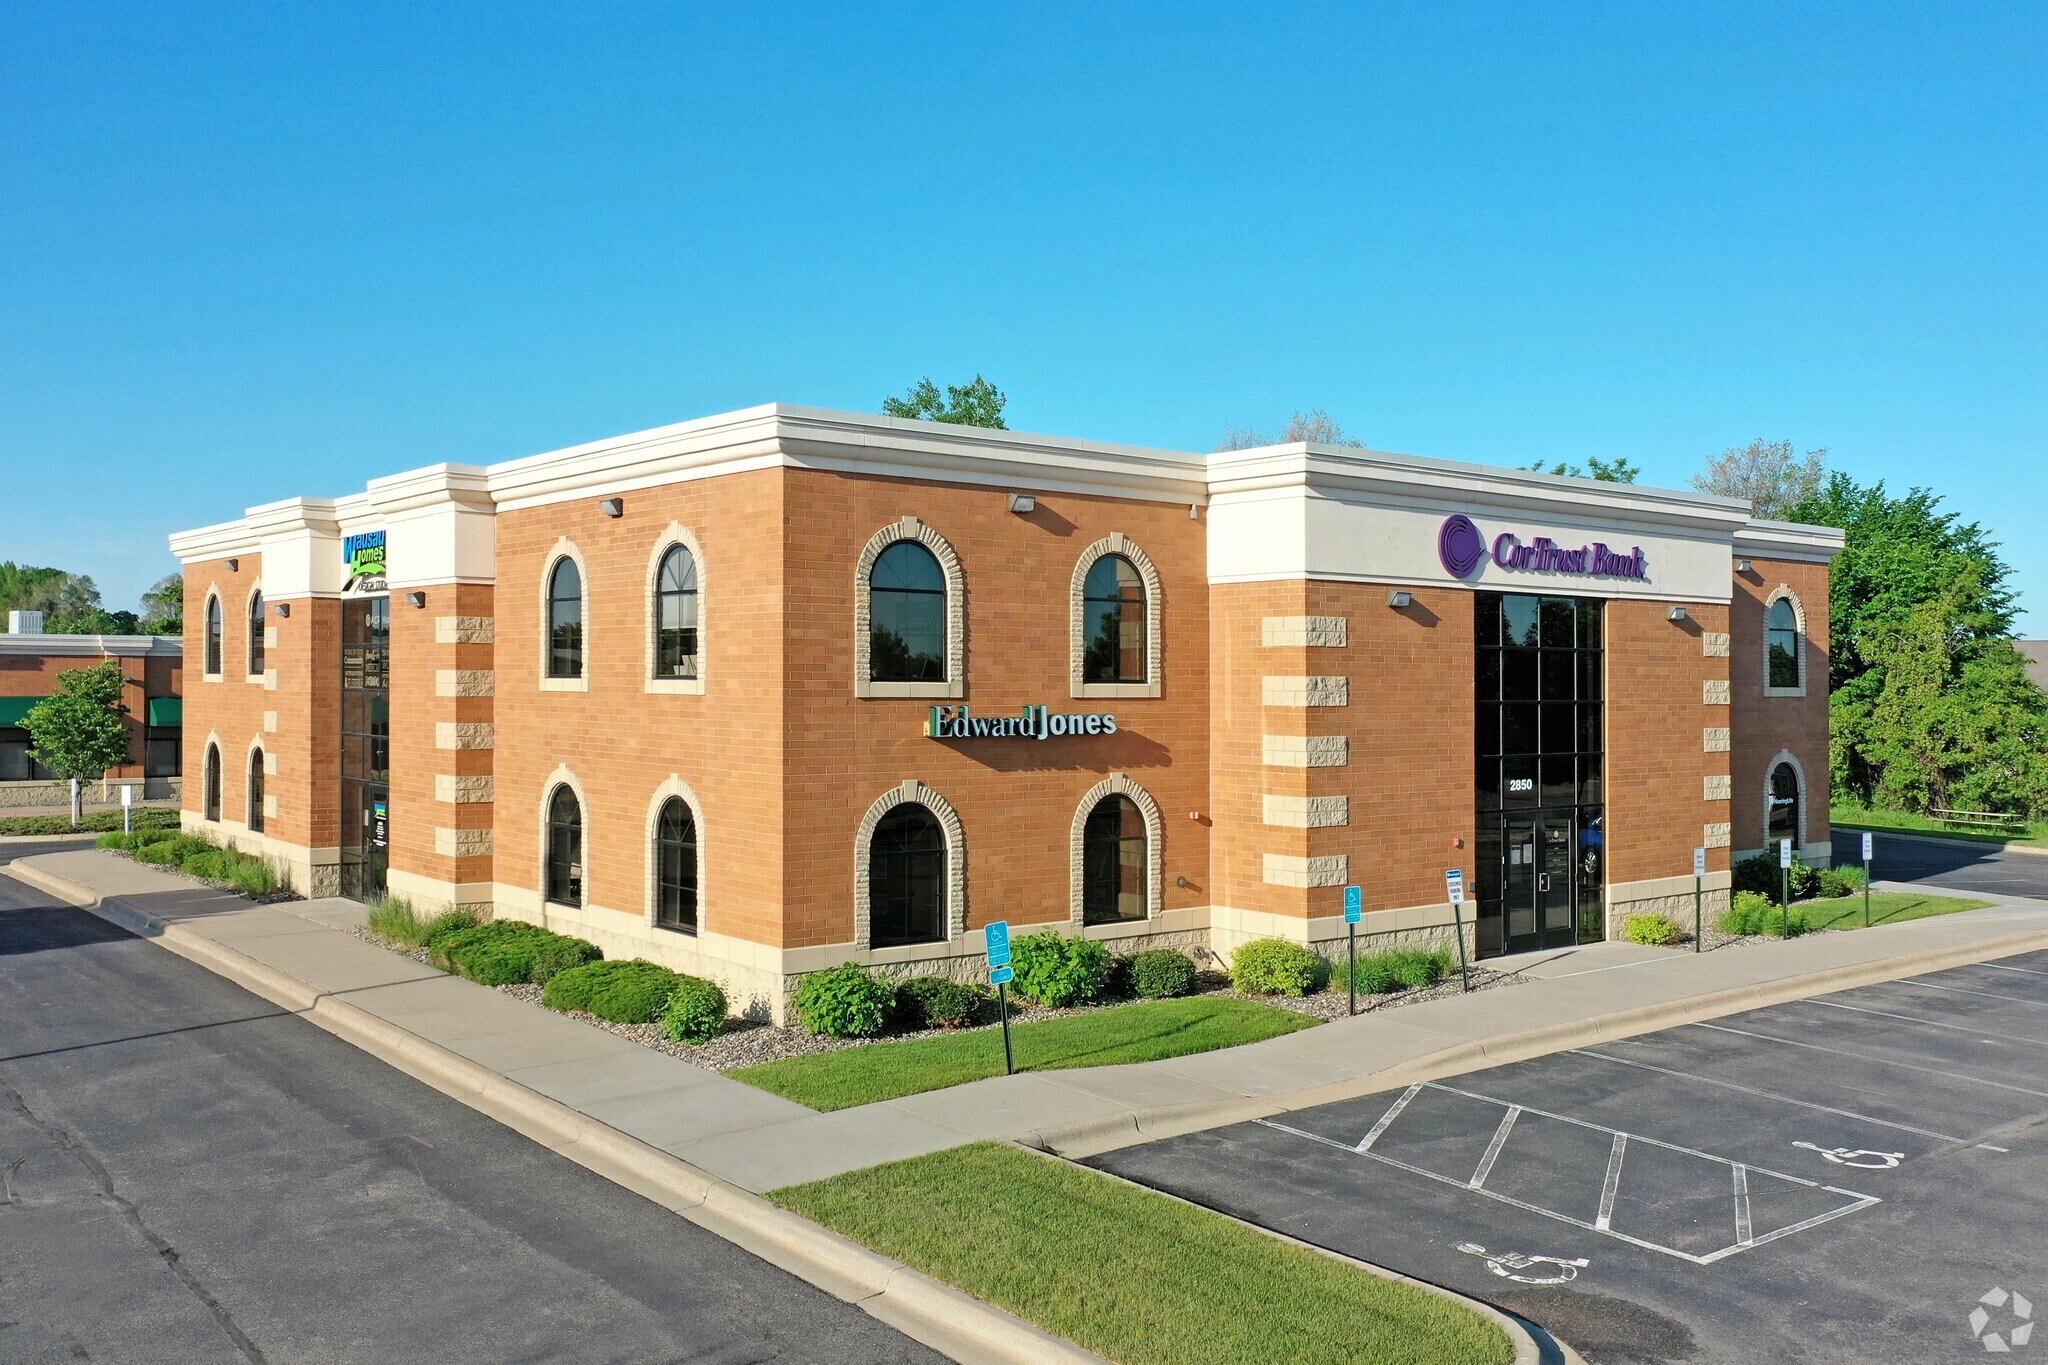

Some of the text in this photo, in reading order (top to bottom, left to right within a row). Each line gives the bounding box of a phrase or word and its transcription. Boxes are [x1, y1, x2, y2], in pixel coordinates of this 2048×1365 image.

[344, 530, 385, 564] Wausau
[351, 546, 384, 573] Homes
[1492, 532, 1644, 577] CorTrust Bank
[1509, 778, 1533, 791] 2850
